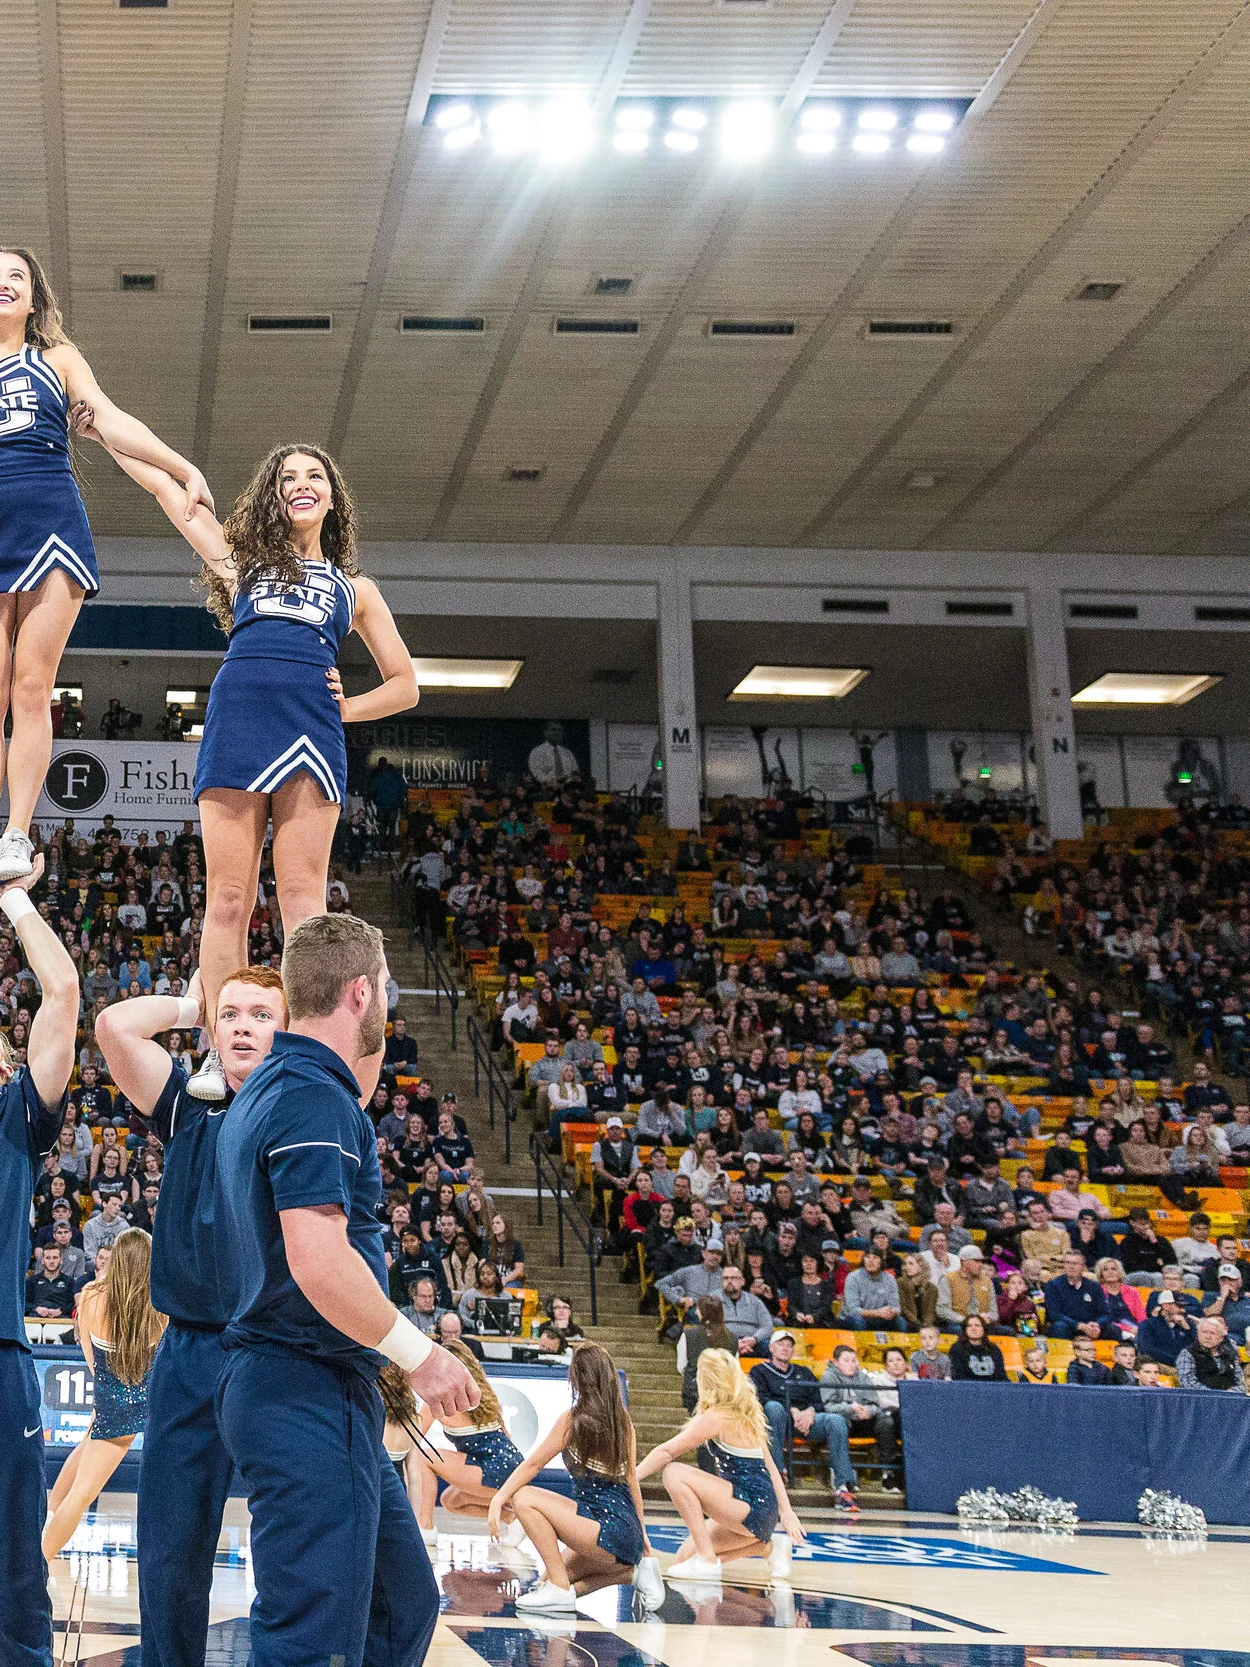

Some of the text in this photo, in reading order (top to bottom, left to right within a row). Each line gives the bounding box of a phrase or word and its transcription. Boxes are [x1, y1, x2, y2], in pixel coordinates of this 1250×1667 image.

[249, 580, 337, 615] STATE
[673, 727, 690, 743] M
[1052, 737, 1069, 753] N
[62, 764, 90, 799] F
[119, 759, 196, 790] Fish
[114, 792, 153, 804] Home
